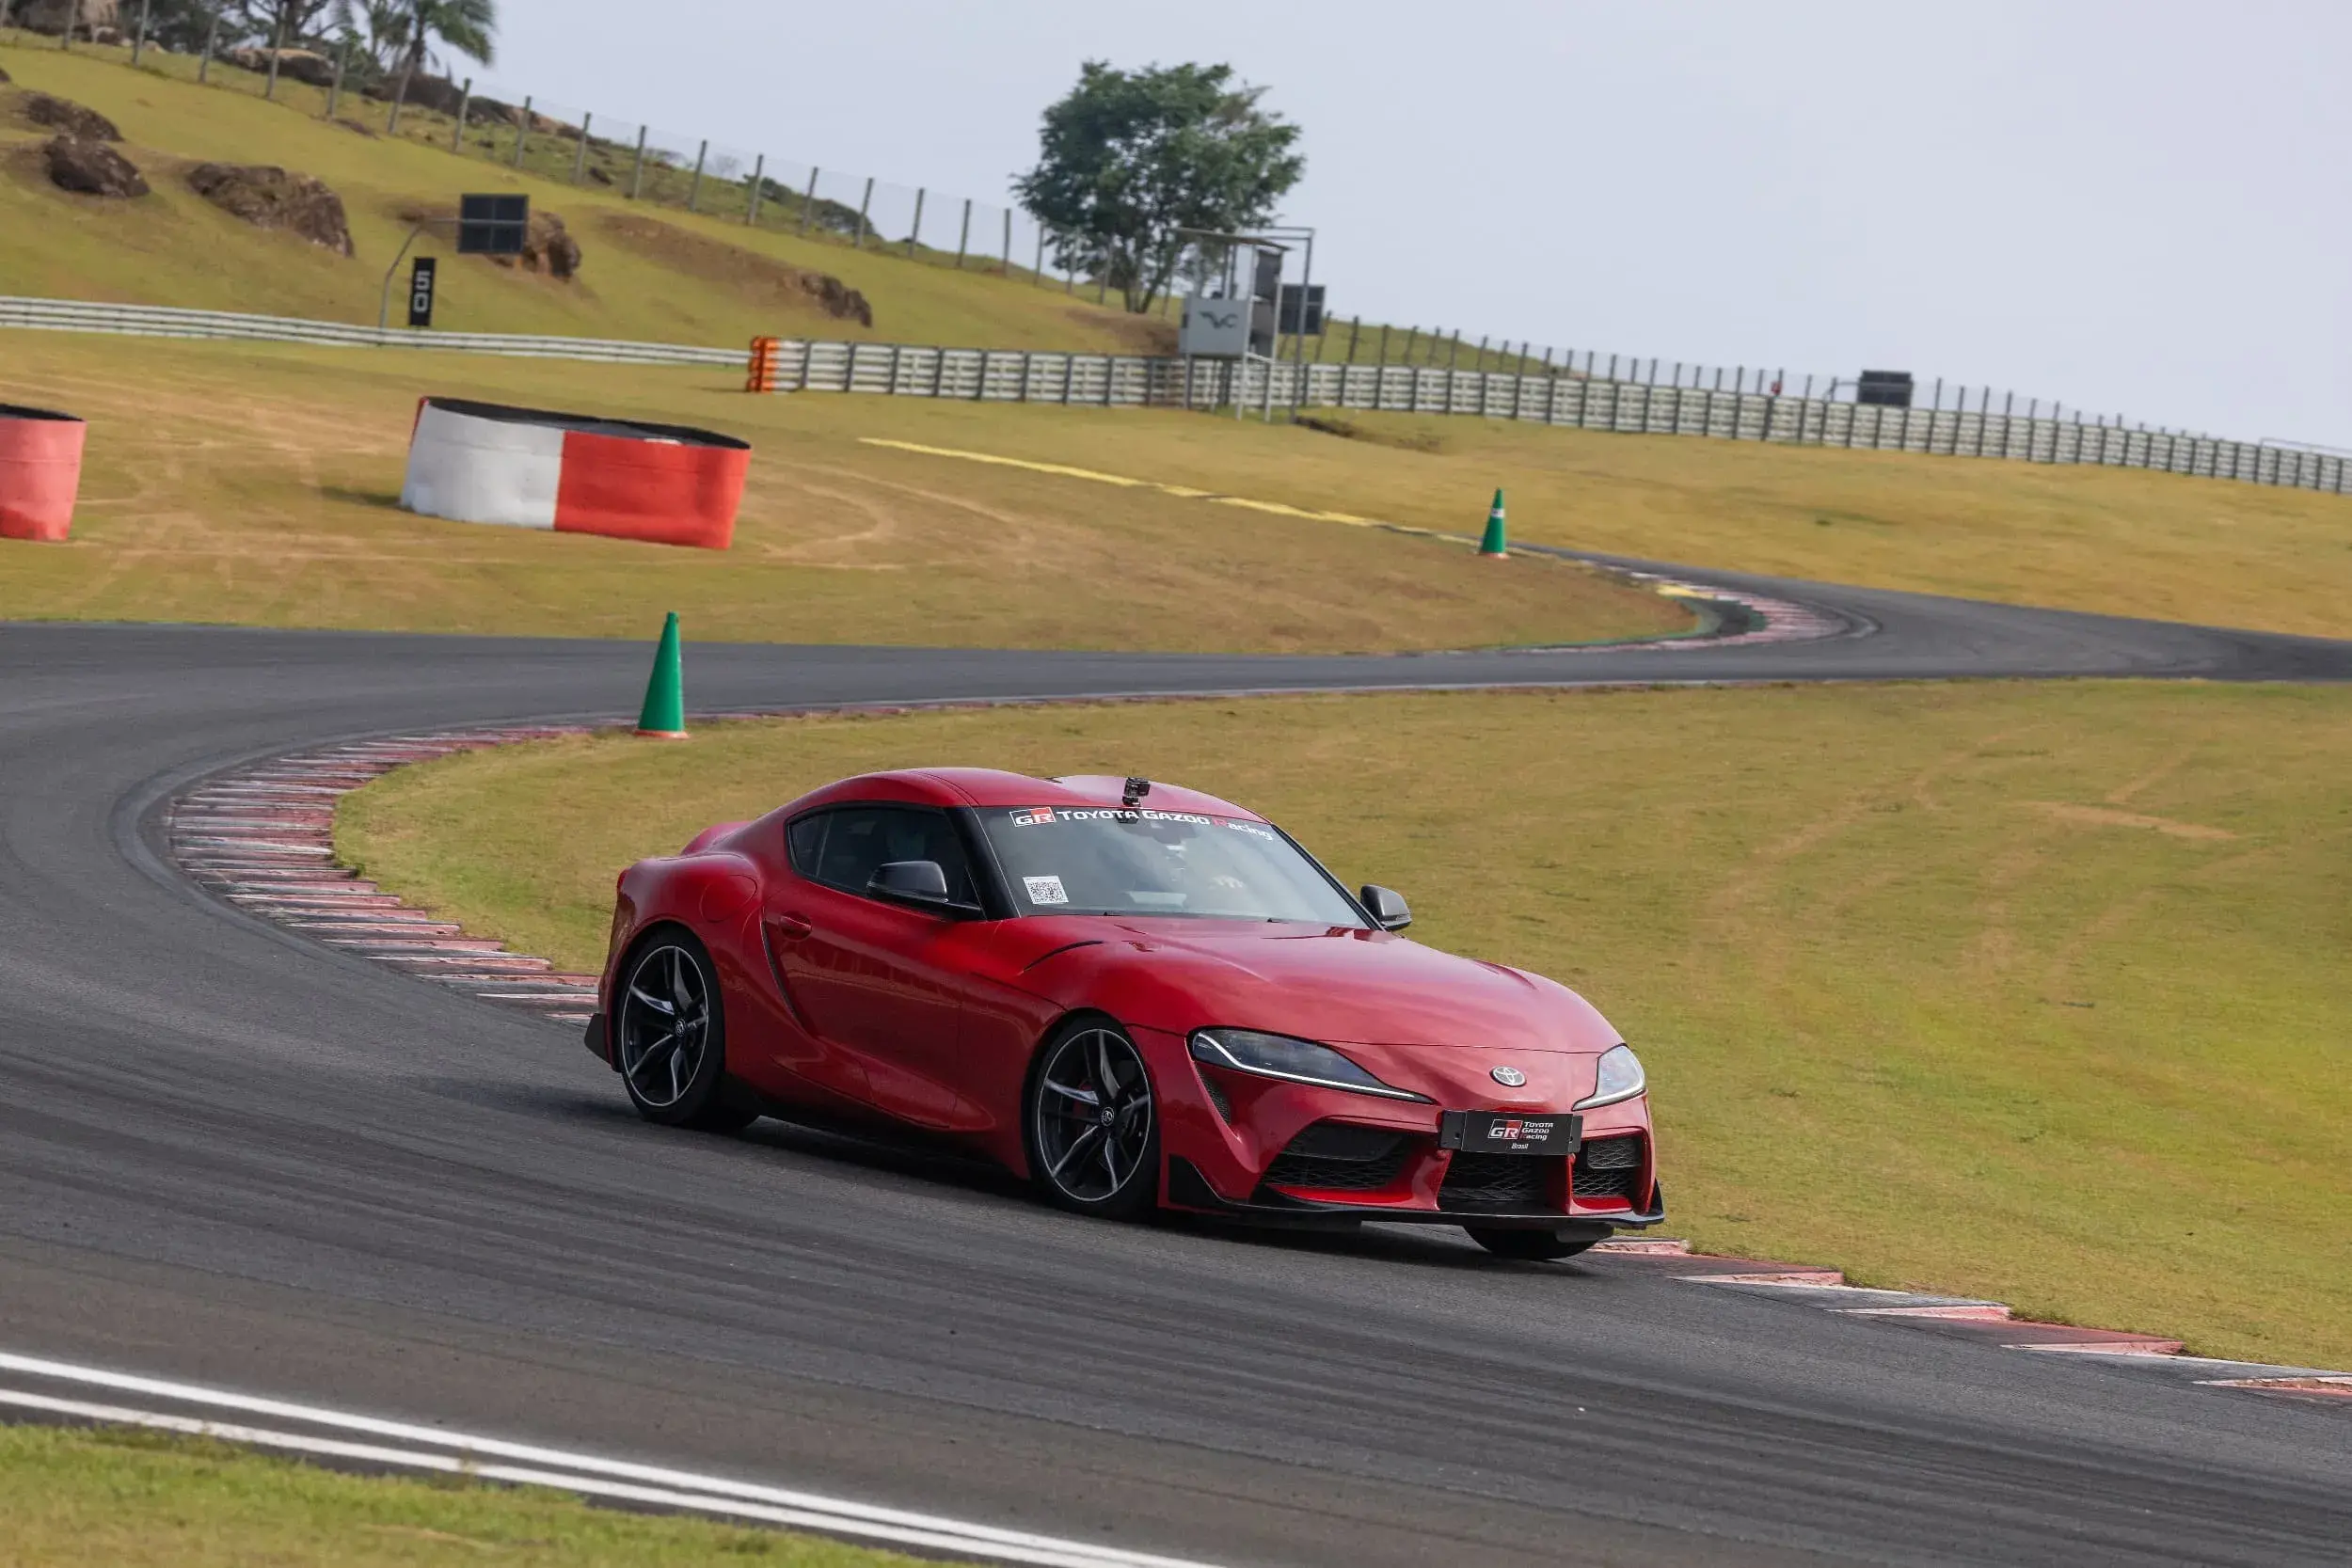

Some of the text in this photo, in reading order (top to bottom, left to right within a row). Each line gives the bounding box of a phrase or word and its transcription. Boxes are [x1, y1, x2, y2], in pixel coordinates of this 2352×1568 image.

[1057, 810, 1139, 821] TOYOTA
[1141, 810, 1211, 825] GAZOO
[1211, 817, 1273, 841] Racing
